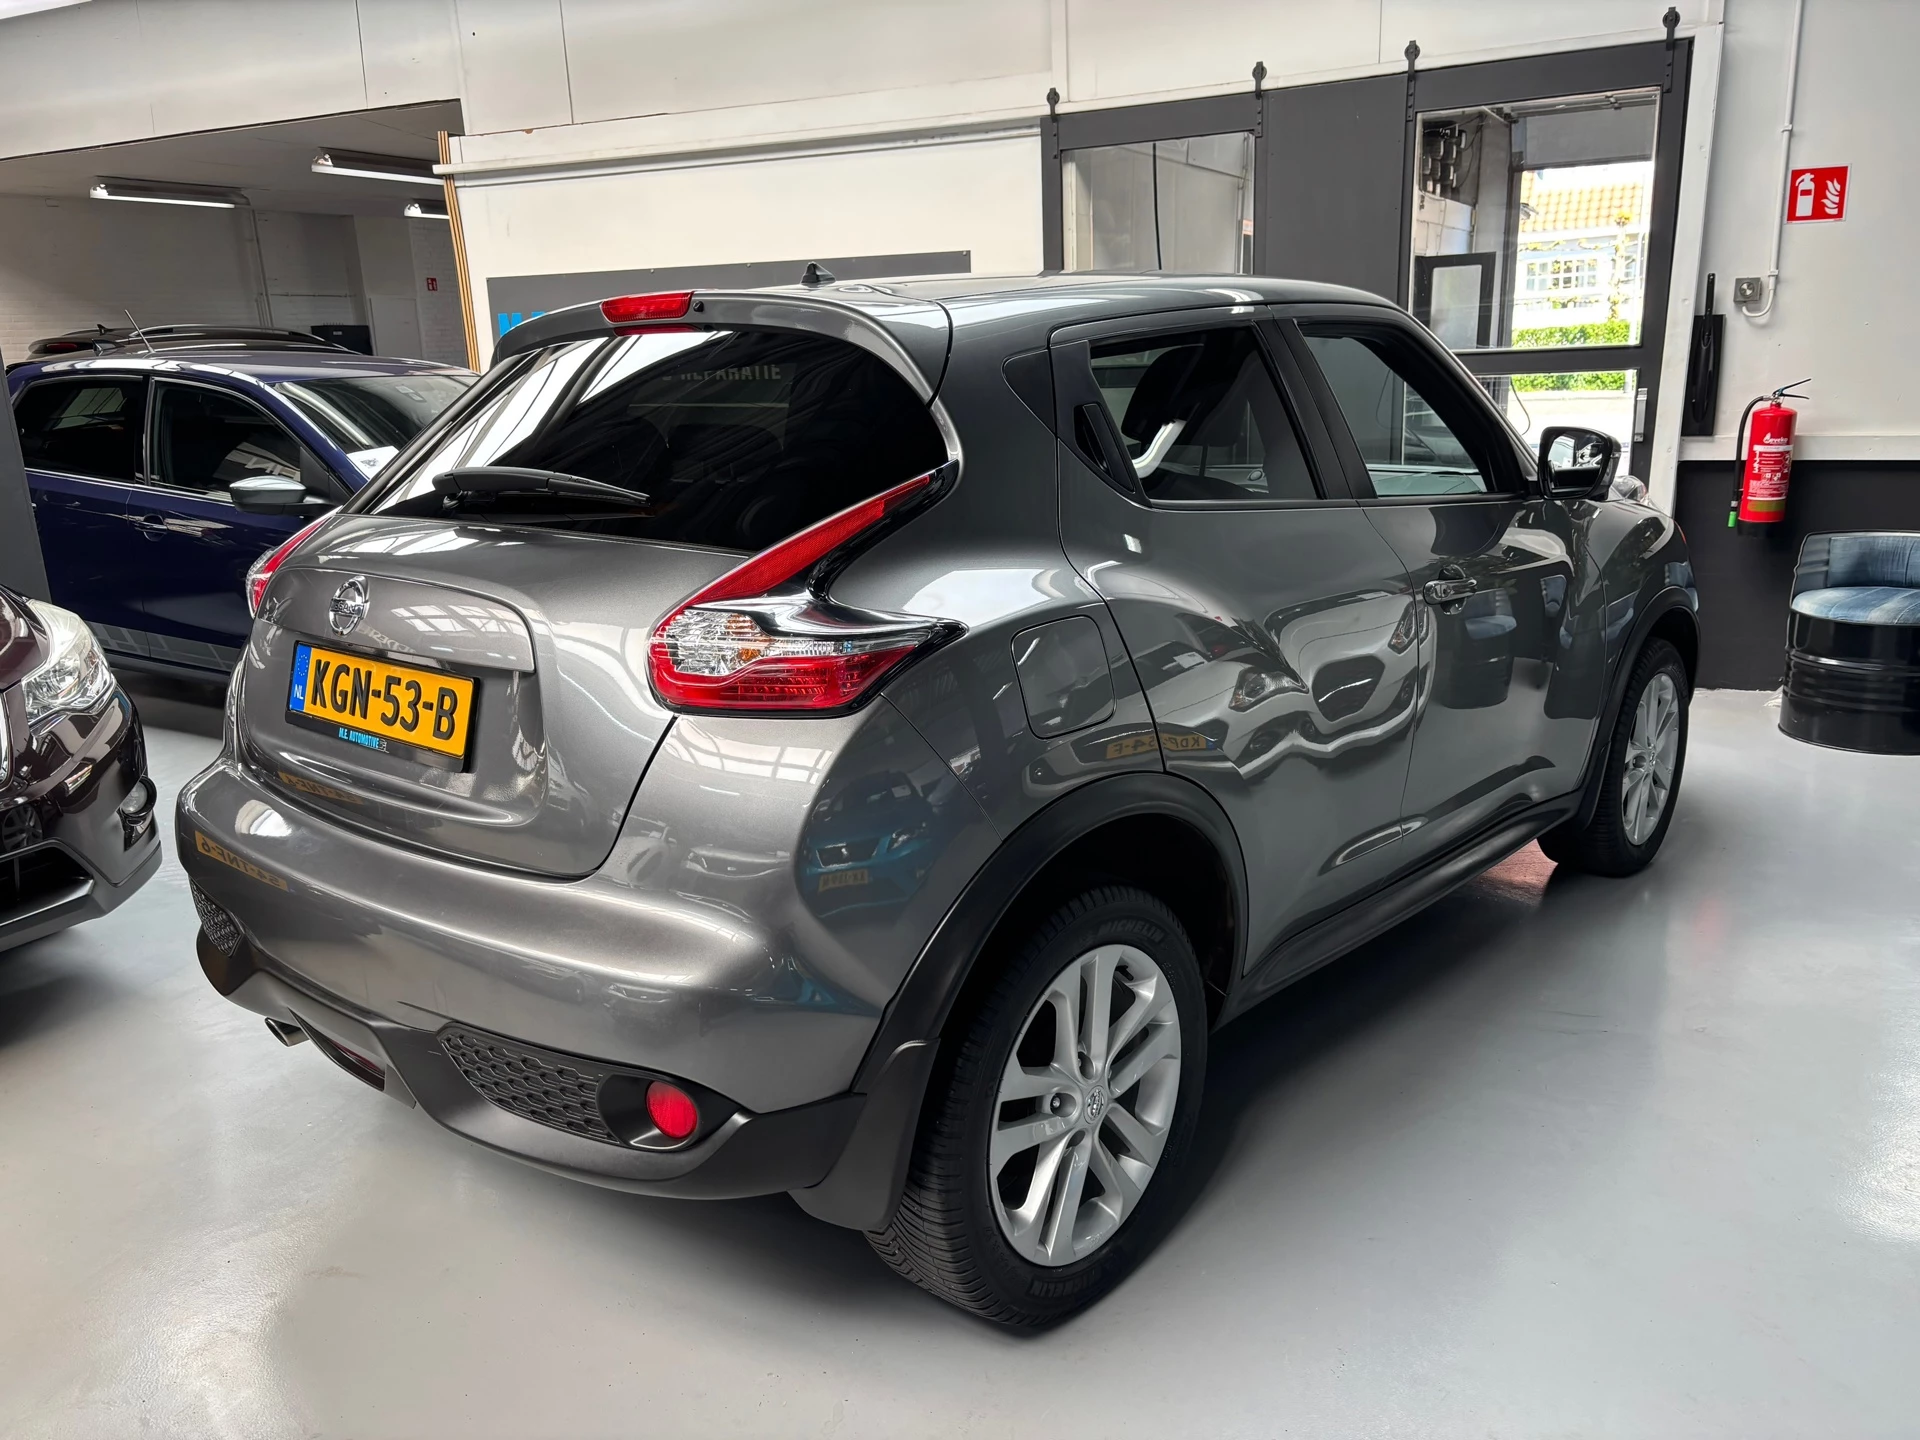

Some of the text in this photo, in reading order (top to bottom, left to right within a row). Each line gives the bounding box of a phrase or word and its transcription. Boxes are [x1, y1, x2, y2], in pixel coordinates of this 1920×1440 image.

[293, 684, 304, 701] NL
[309, 658, 459, 742] KGN-53-B
[349, 730, 380, 749] AUTOMOTIVE
[1098, 918, 1165, 943] MICHELIN
